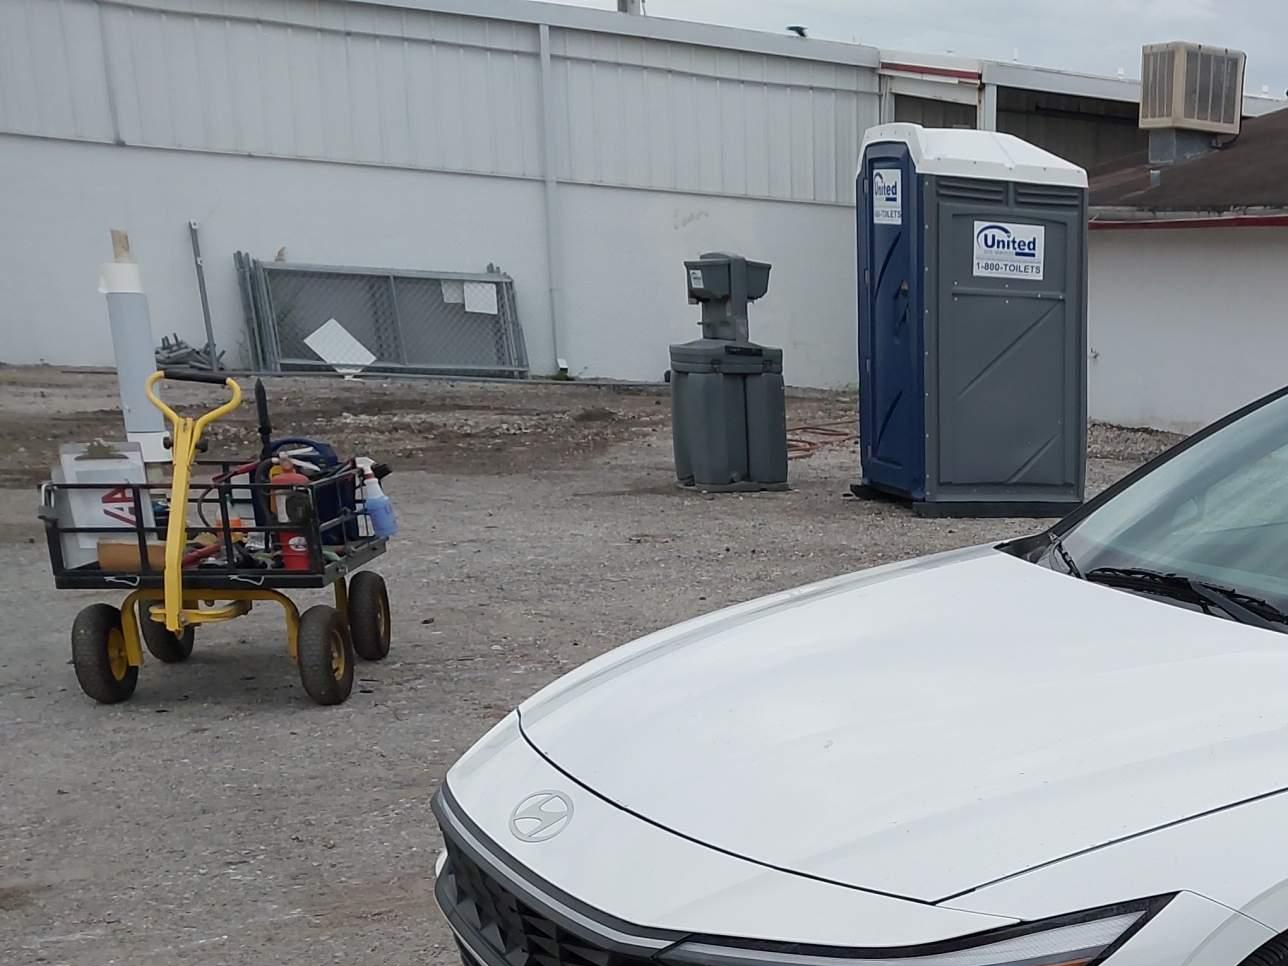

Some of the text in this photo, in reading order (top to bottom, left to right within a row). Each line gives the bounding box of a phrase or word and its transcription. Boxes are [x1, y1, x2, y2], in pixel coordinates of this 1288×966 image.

[875, 181, 897, 196] United
[984, 233, 1036, 251] United
[977, 262, 1041, 274] 1-800-TOILETS
